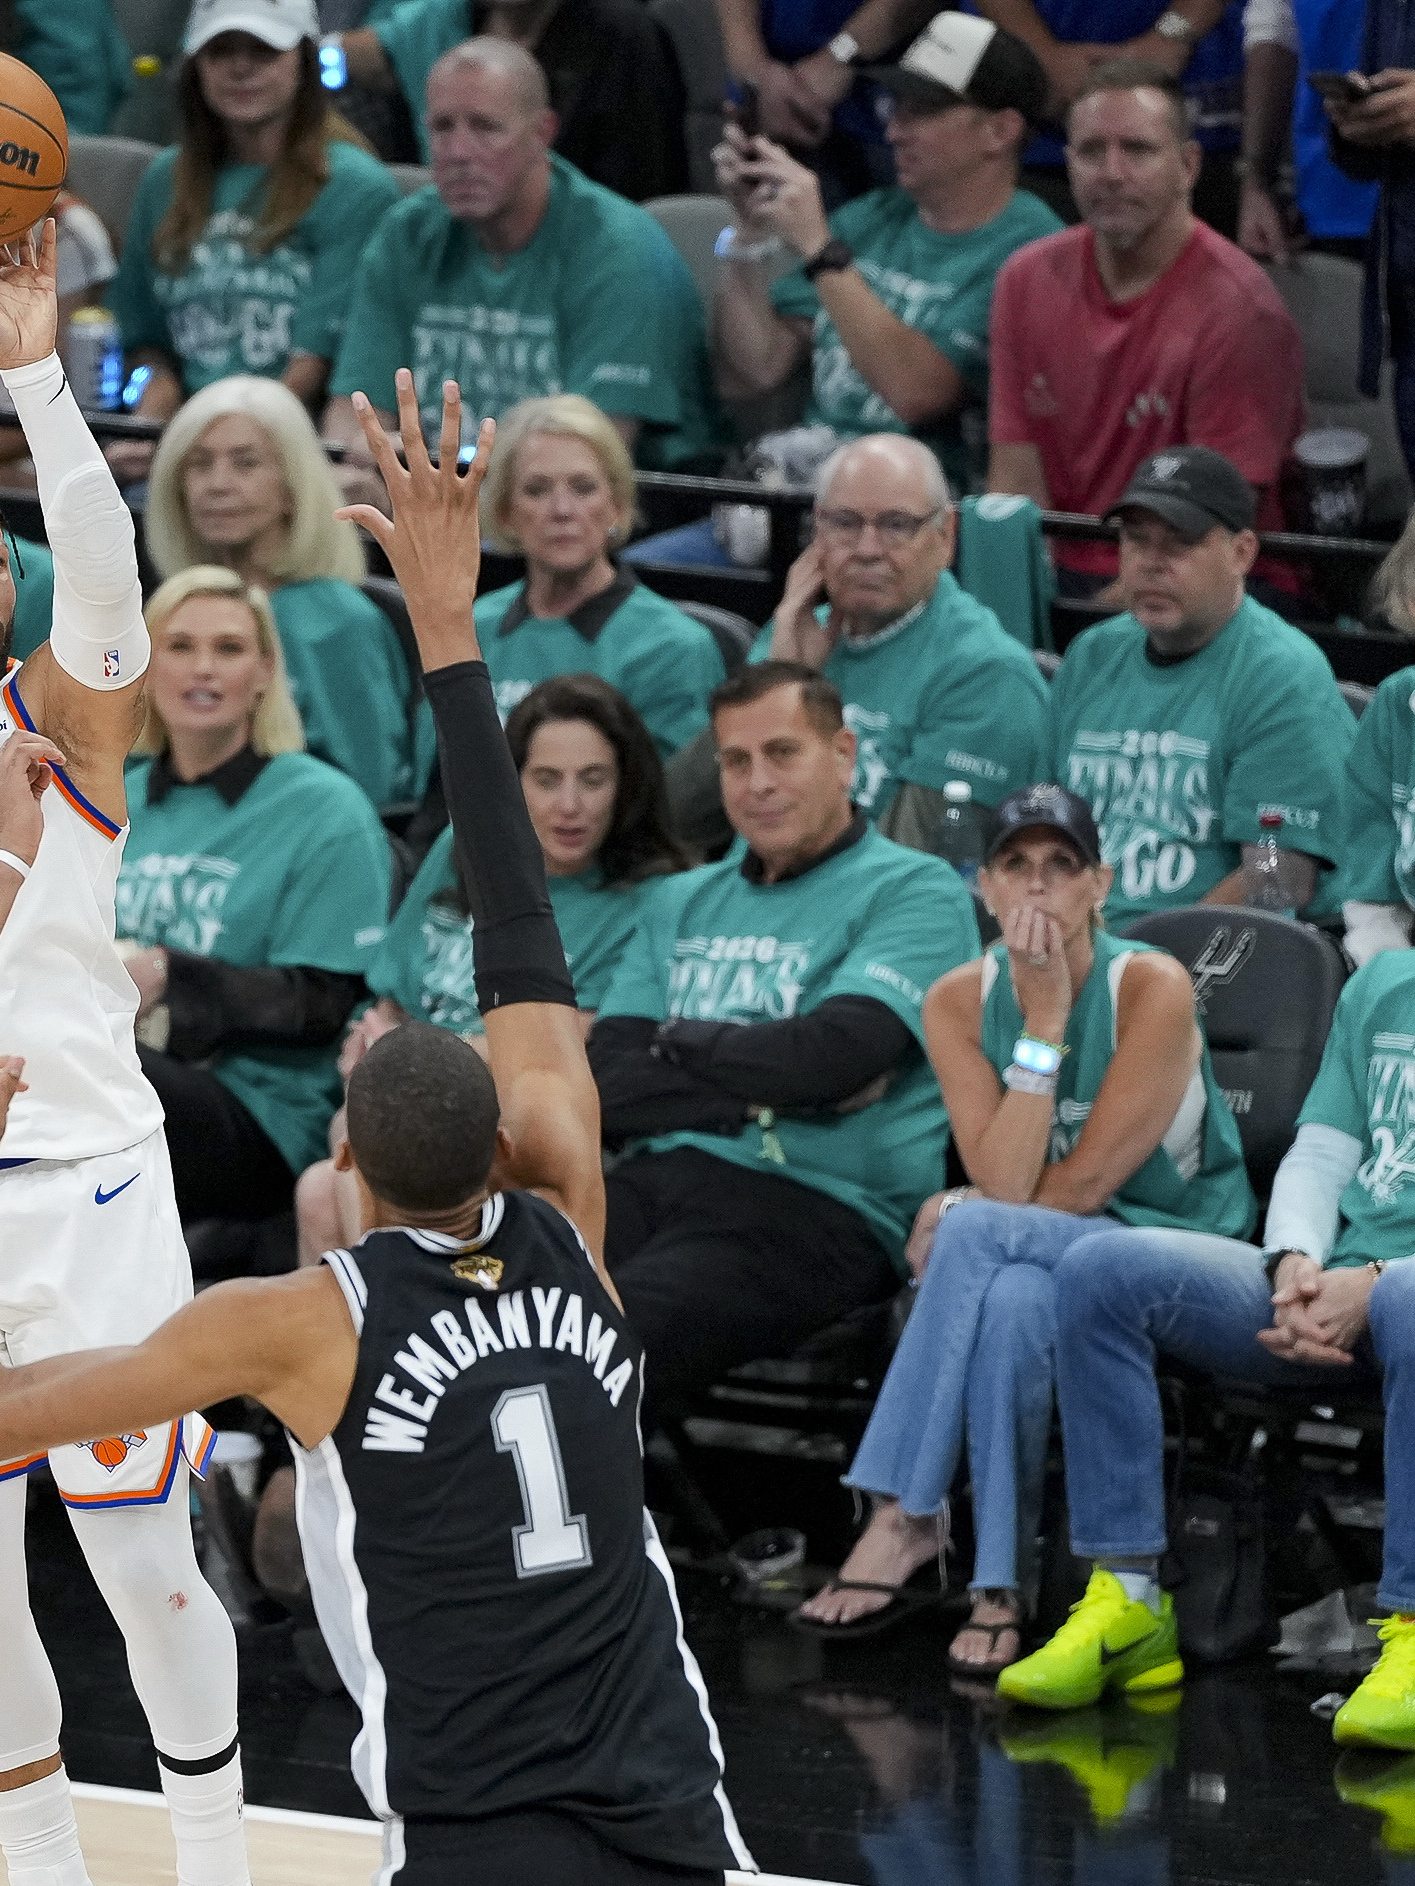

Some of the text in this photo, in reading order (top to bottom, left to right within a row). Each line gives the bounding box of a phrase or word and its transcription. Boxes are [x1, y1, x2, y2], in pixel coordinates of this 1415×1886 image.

[1120, 828, 1196, 900] GO
[361, 1286, 634, 1453] WEMBANYAMA
[489, 1383, 593, 1579] 1
